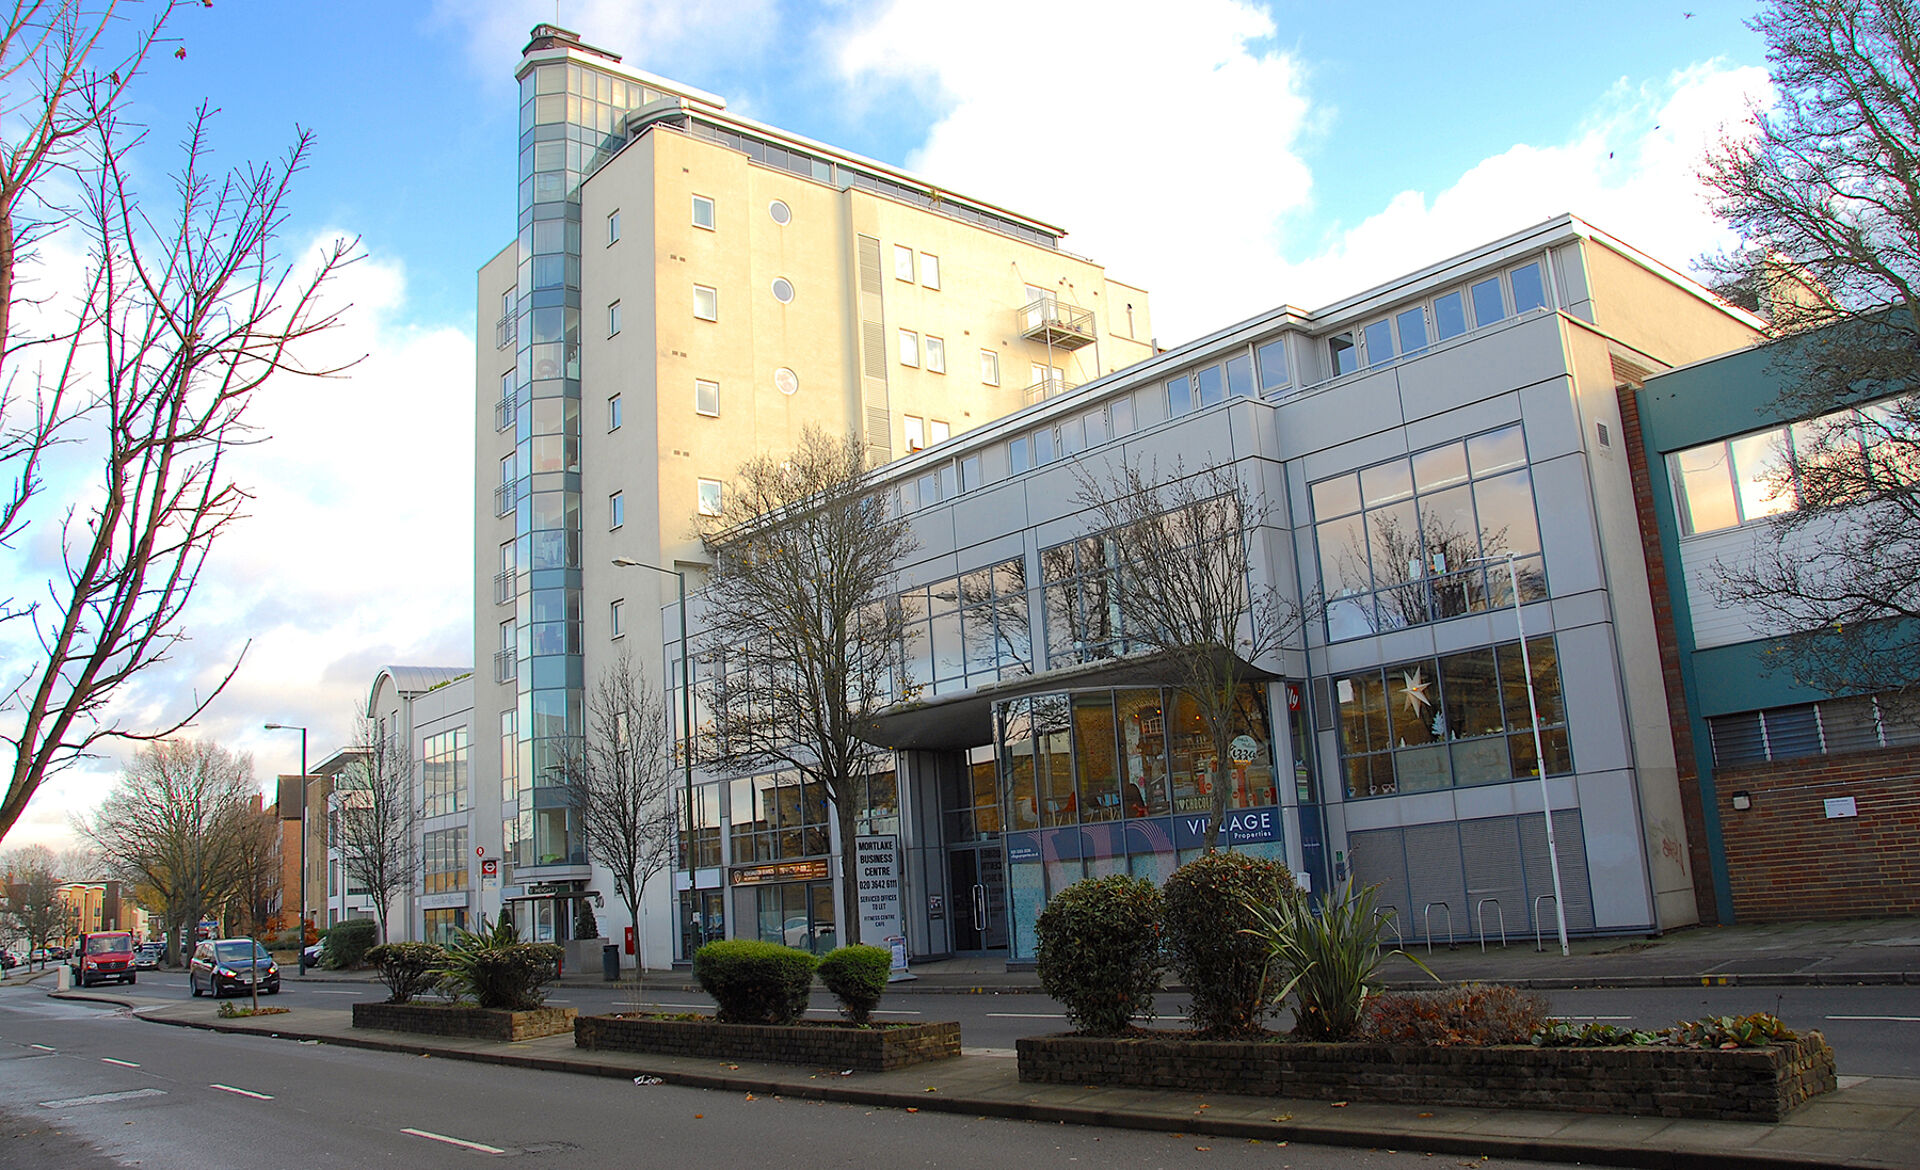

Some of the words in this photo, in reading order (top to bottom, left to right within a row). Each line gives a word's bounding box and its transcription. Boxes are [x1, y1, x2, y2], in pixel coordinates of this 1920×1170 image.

[1234, 830, 1272, 840] Properties
[858, 841, 893, 851] MORTLAKE
[860, 854, 893, 864] BUSINESS
[864, 867, 890, 877] CENTRE
[859, 881, 870, 890] 020
[594, 896, 605, 909] 30
[881, 894, 897, 902] OFFICES
